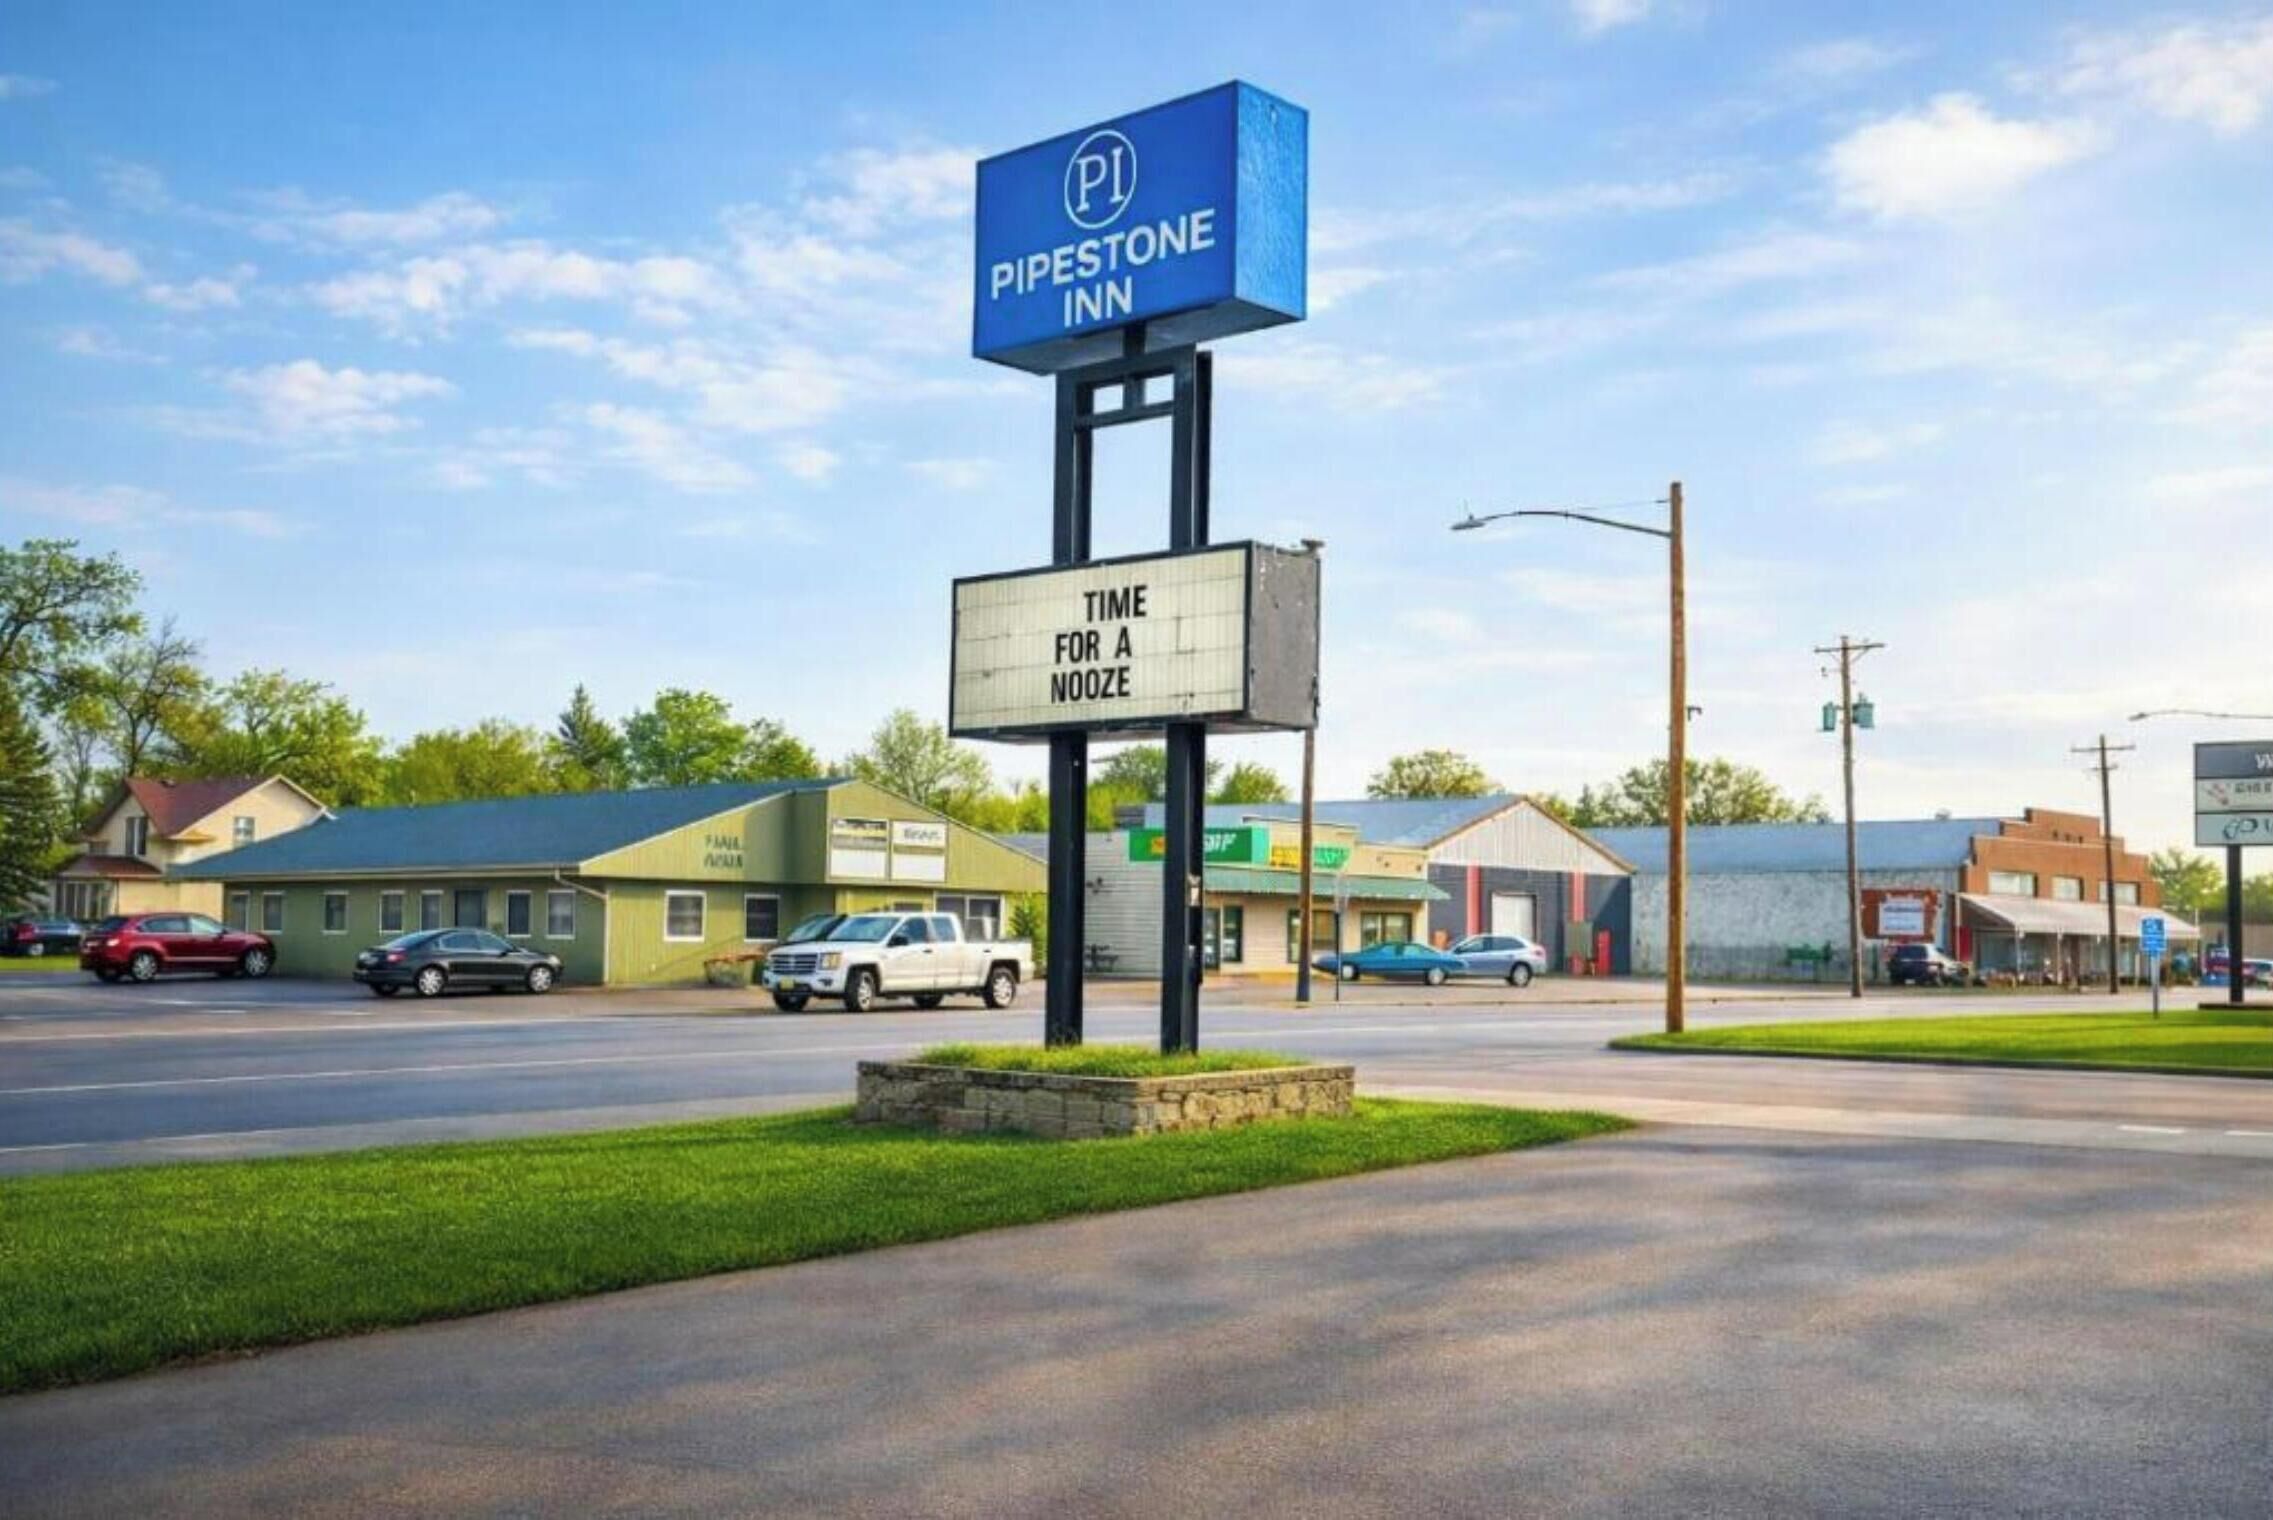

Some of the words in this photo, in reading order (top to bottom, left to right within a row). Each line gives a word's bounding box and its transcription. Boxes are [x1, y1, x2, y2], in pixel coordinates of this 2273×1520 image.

[1075, 146, 1125, 213] PI
[990, 208, 1216, 300] PIPESTONE
[1063, 276, 1133, 328] INN
[1083, 584, 1148, 622] TIME
[1054, 629, 1100, 665] FOR
[1114, 625, 1132, 659] A
[1050, 666, 1131, 704] NOOZE
